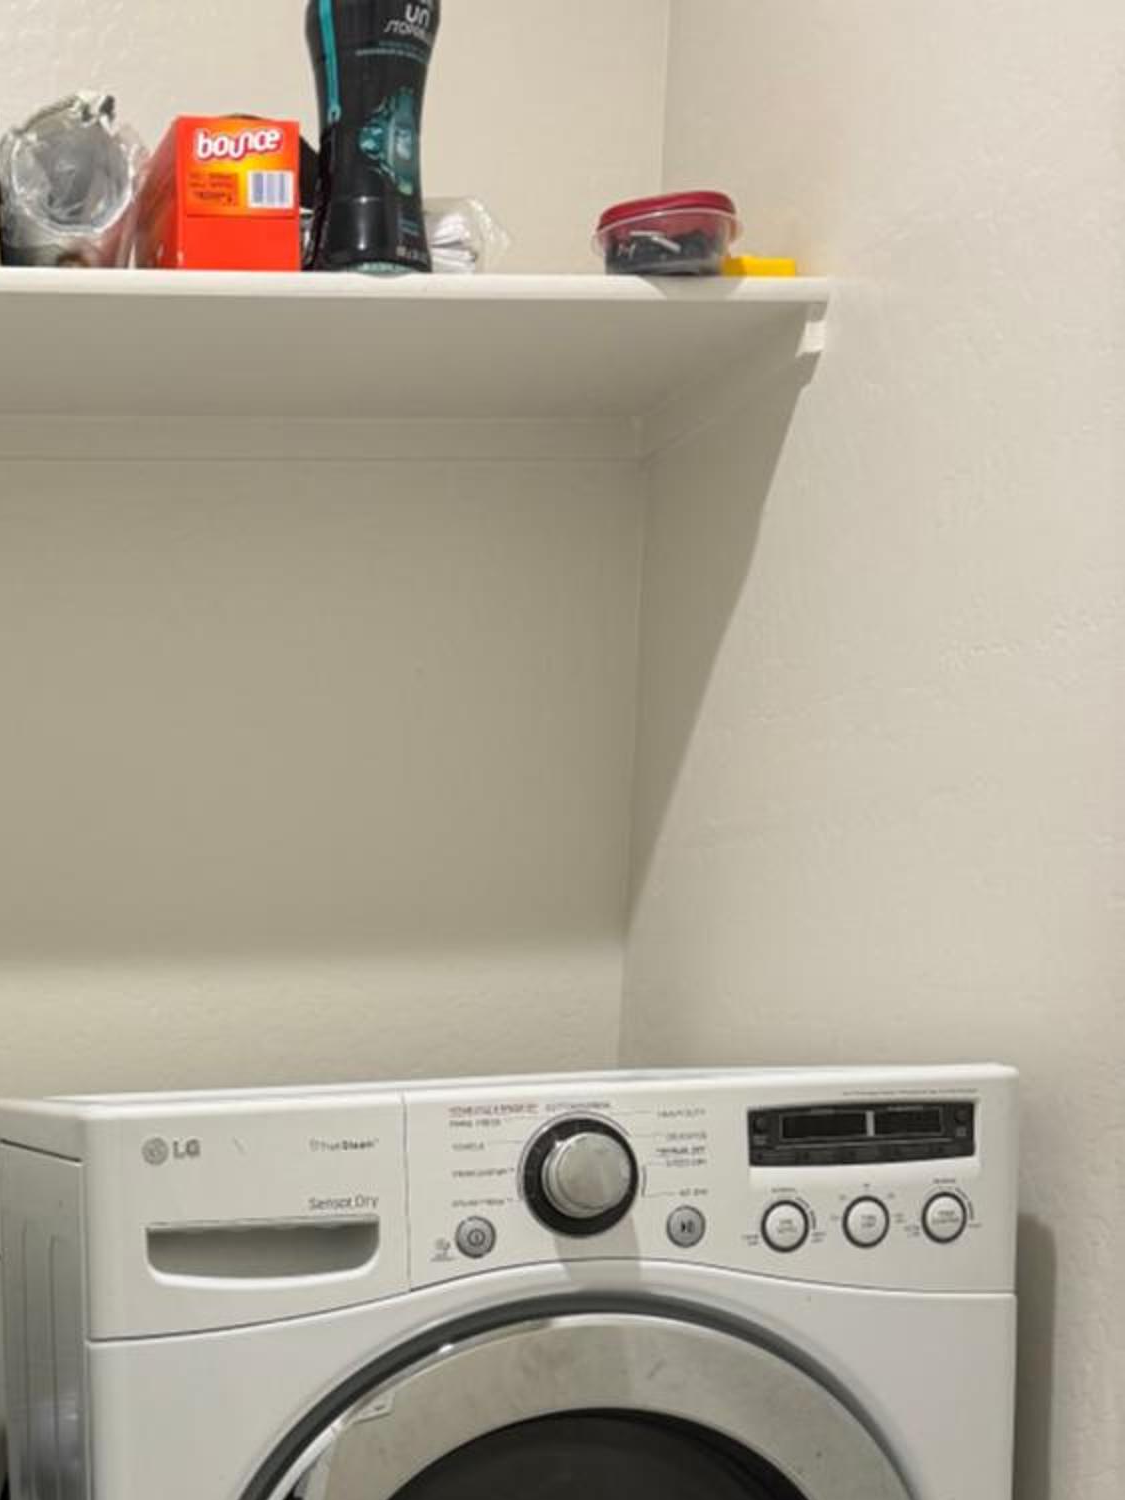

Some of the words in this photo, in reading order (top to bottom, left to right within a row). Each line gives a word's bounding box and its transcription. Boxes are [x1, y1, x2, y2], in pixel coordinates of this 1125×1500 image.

[197, 128, 281, 160] bounce
[173, 1139, 201, 1159] LG
[355, 1193, 380, 1209] Dry
